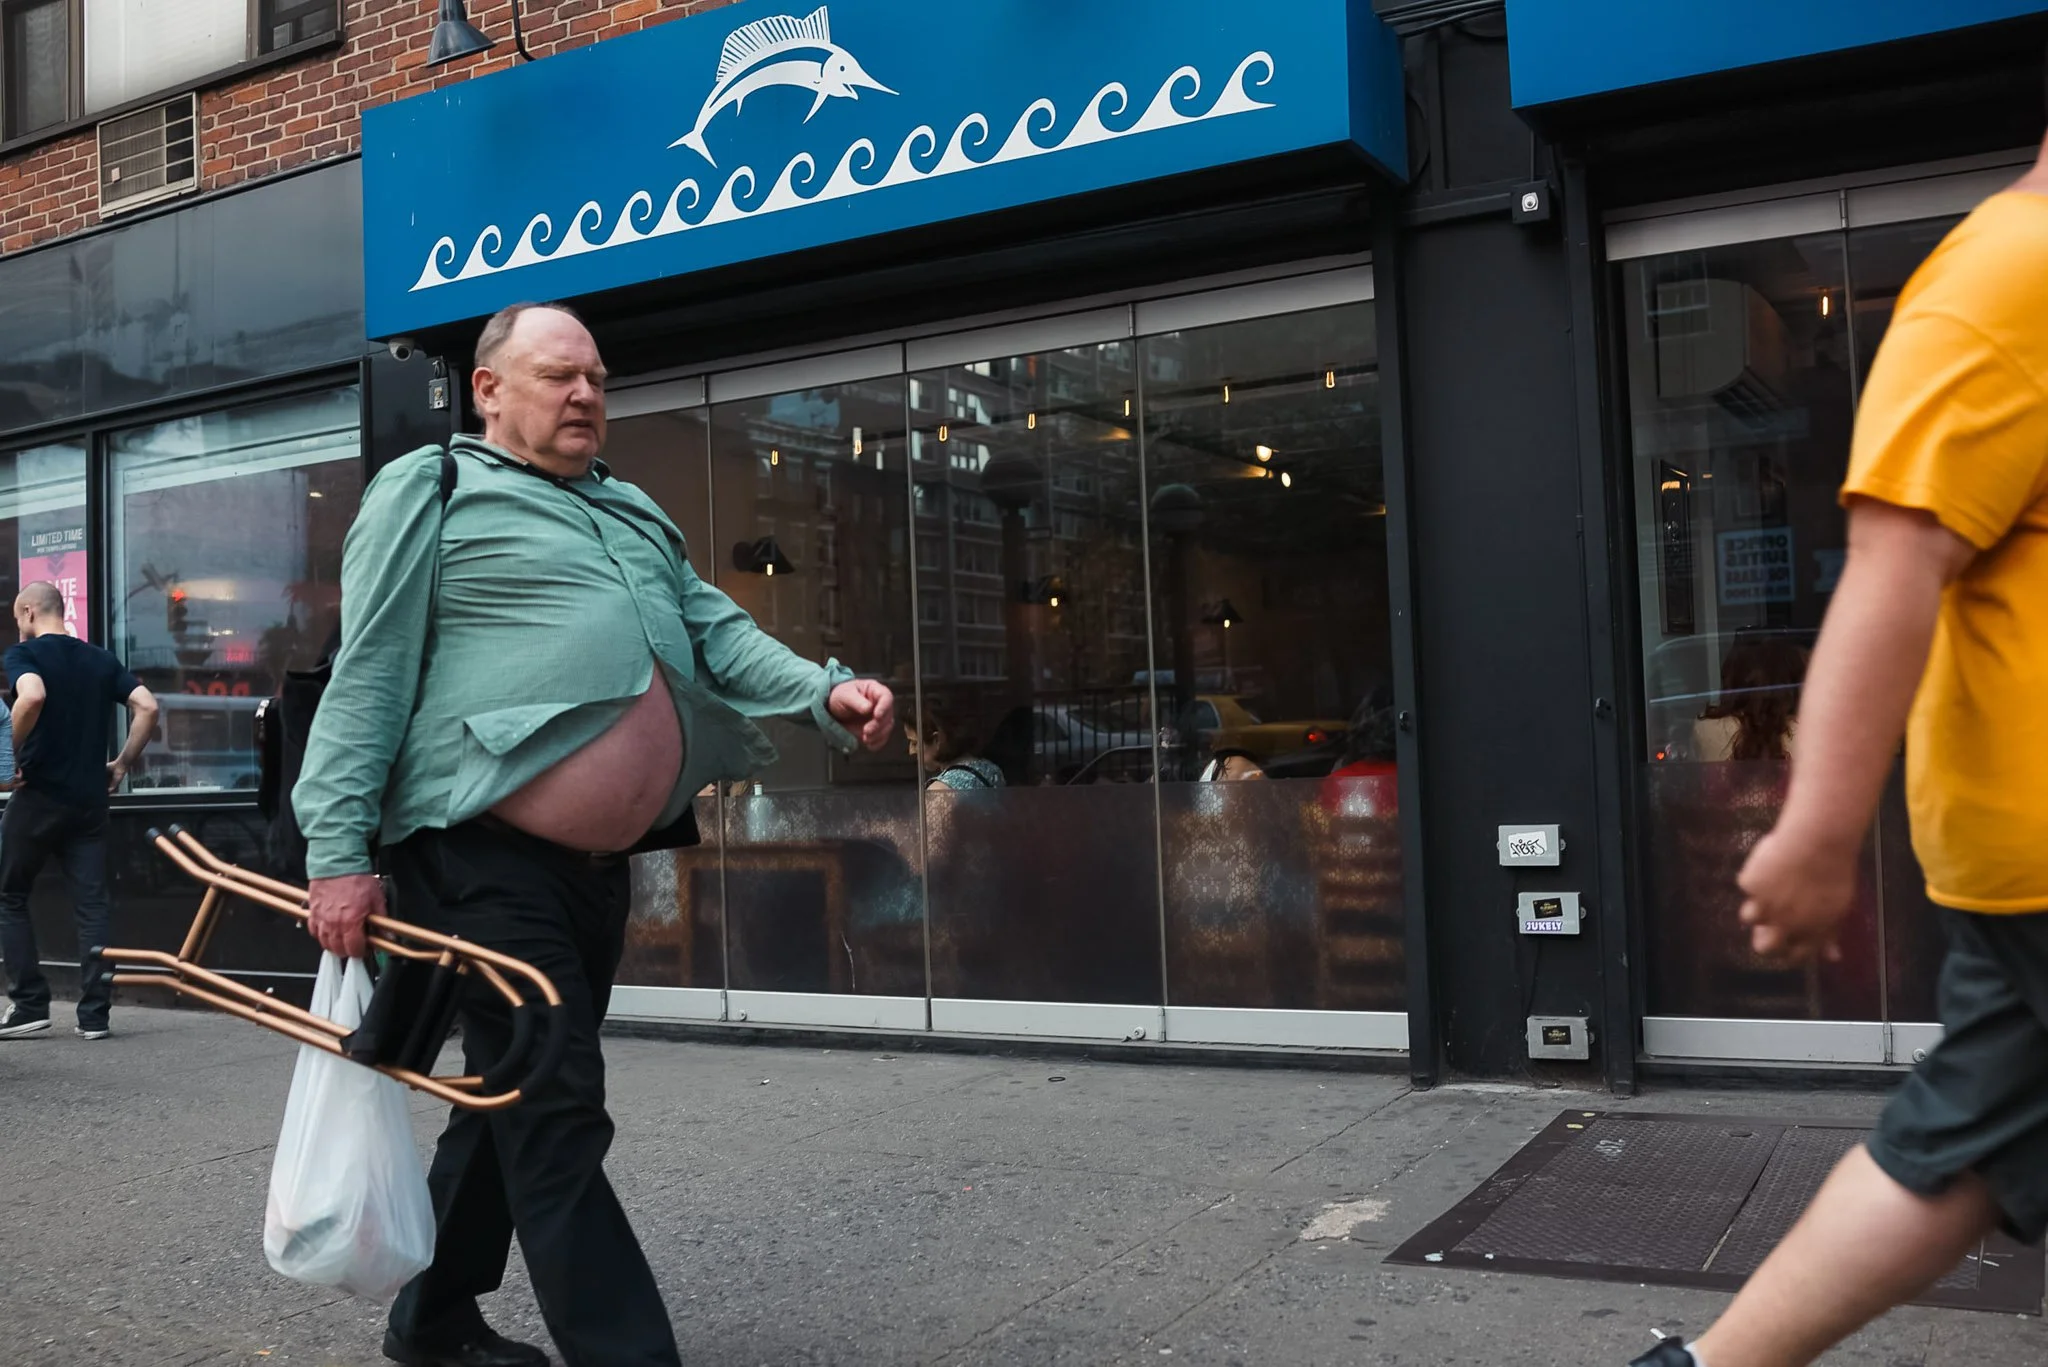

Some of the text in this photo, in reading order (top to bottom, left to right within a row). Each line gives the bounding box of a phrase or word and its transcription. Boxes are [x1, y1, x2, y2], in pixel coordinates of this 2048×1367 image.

[32, 528, 83, 547] LIMITED TIME
[1525, 921, 1563, 932] JUKELY
